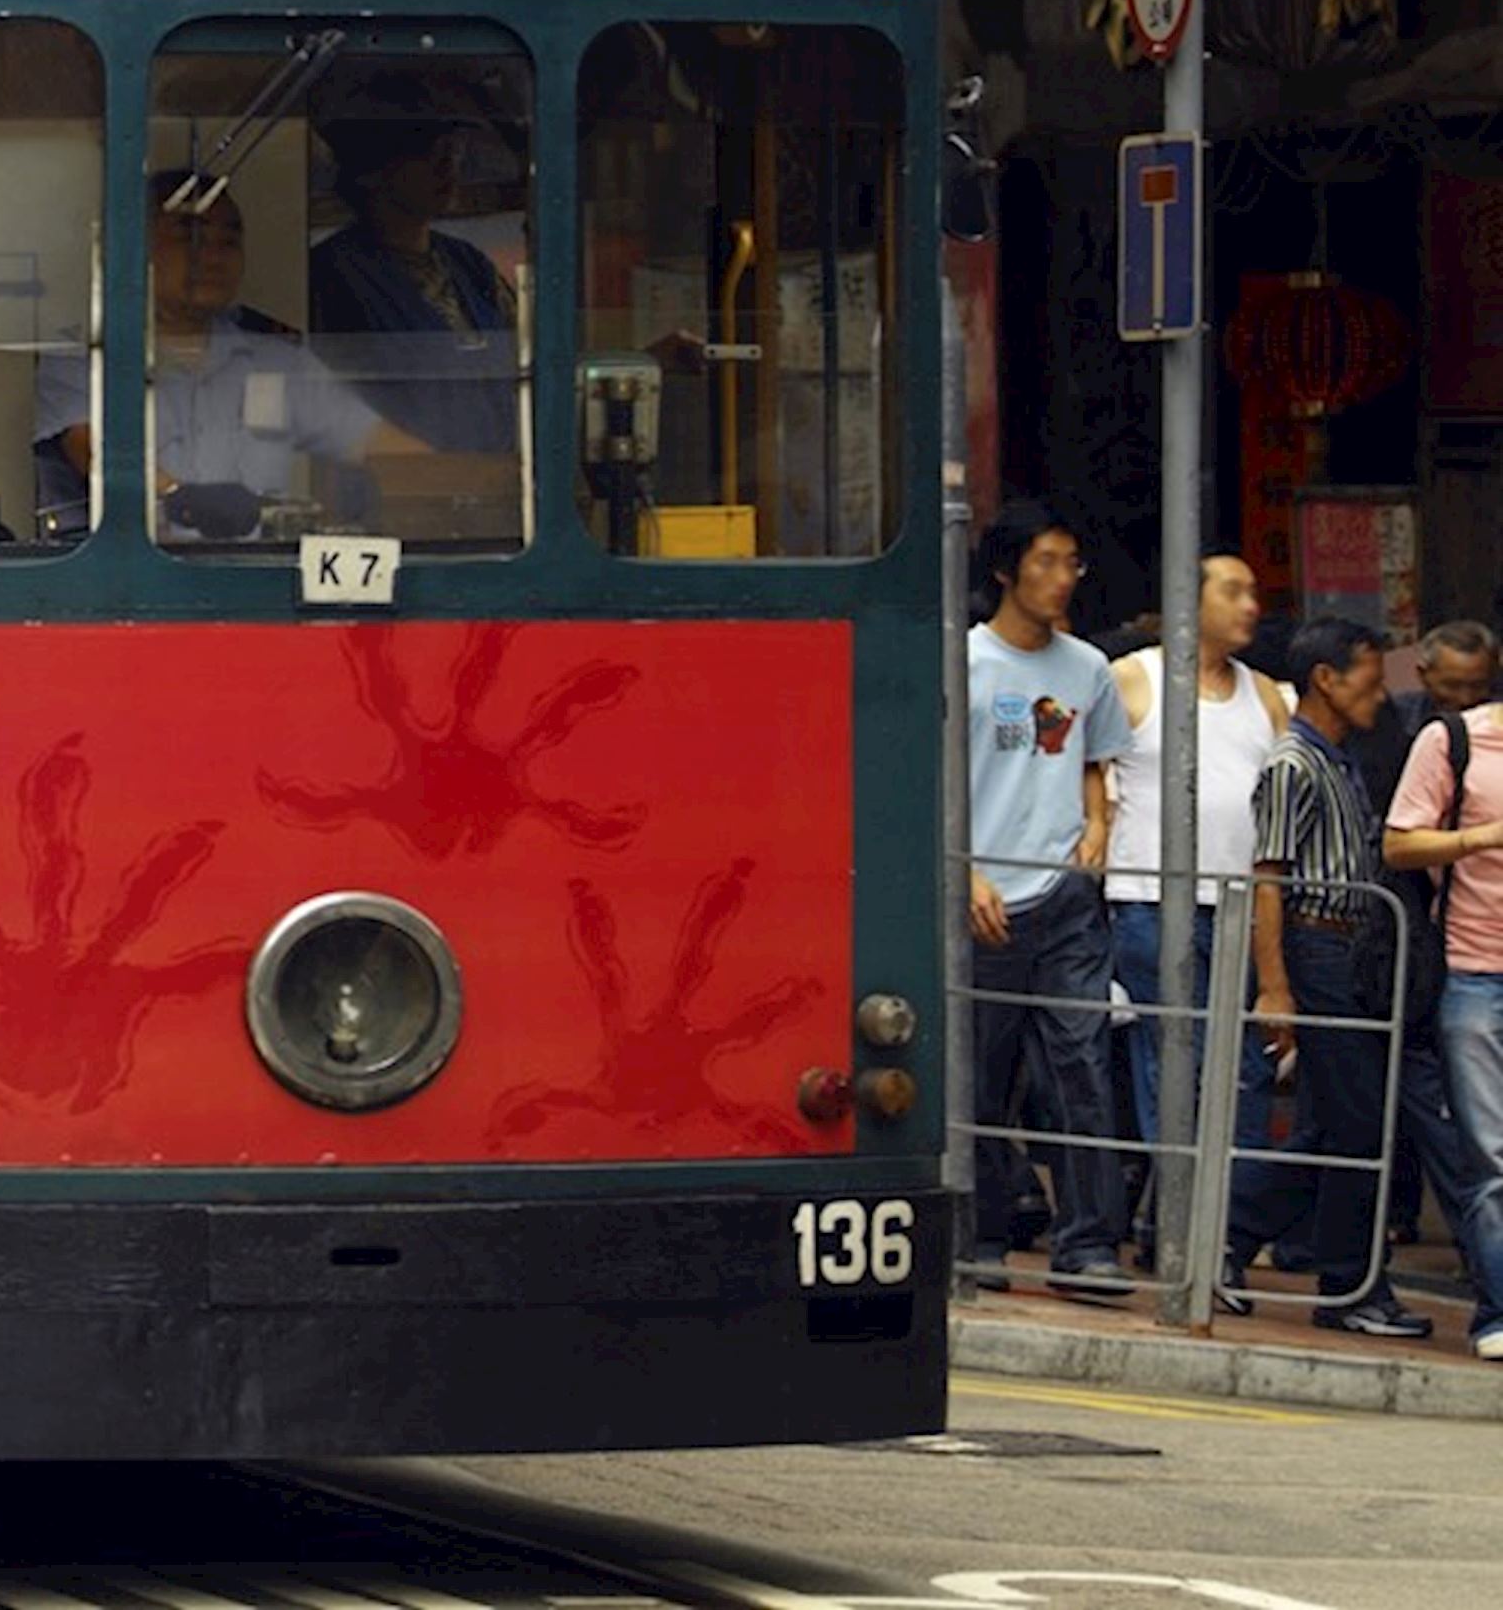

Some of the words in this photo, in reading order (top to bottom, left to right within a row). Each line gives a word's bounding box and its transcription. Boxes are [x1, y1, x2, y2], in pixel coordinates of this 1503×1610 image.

[320, 551, 340, 586] K
[360, 552, 380, 587] 7
[791, 1198, 915, 1288] 136
